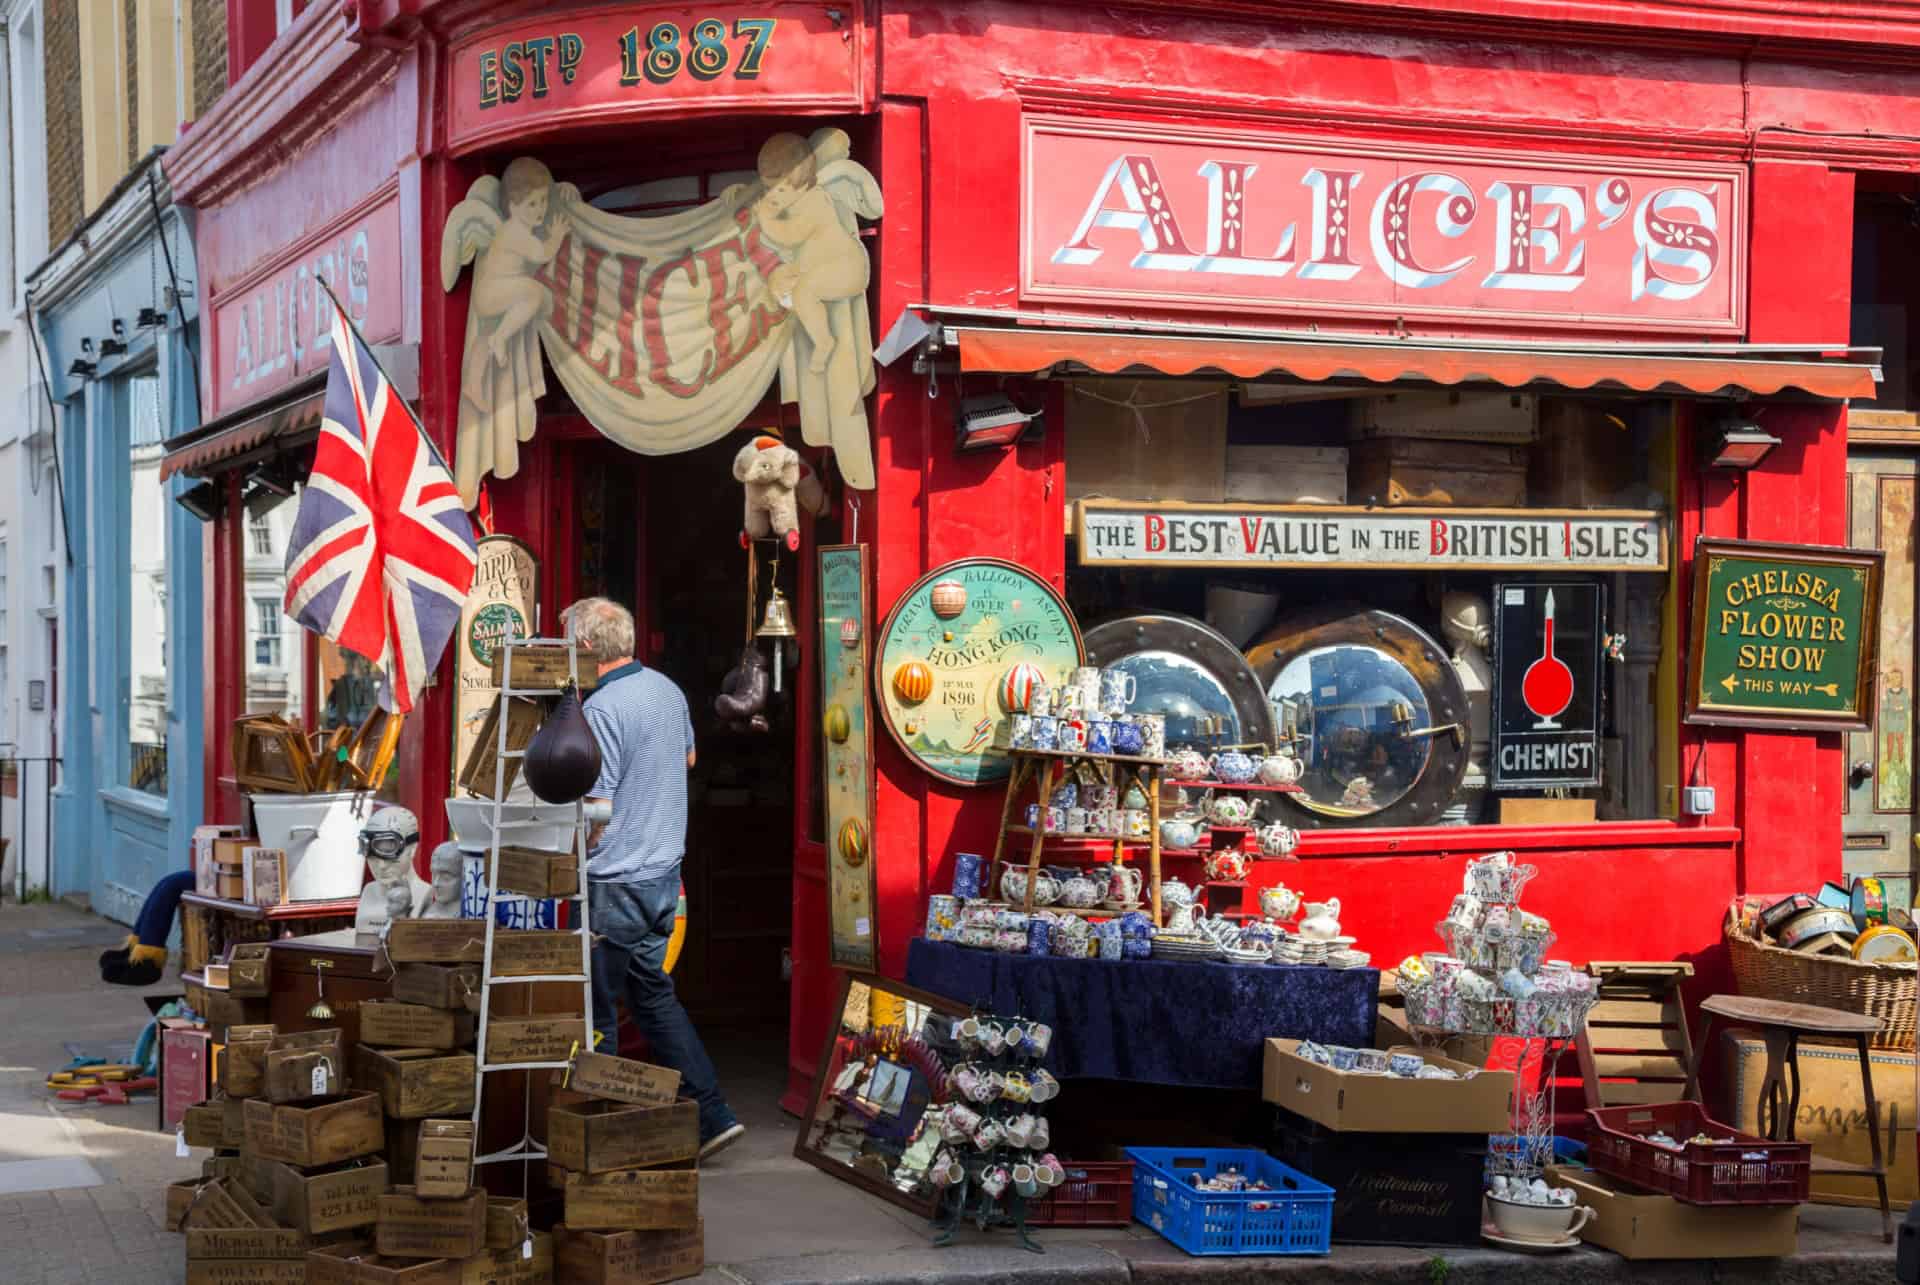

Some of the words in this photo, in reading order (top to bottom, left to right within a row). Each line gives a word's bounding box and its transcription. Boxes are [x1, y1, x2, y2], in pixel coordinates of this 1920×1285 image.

[620, 17, 778, 87] 1887
[1050, 153, 1721, 303] ALICE'S
[1095, 524, 1137, 547] THE
[1144, 513, 1228, 554] BEST
[1239, 516, 1340, 555] VALUE
[1350, 528, 1371, 550] IN
[1381, 529, 1421, 550] THE
[1429, 518, 1549, 558] BRITISH
[1563, 520, 1650, 559] ISLES
[899, 594, 931, 636] GRAND
[962, 569, 1029, 592] BALLOON
[1032, 593, 1071, 648] ASCENT
[970, 600, 1006, 612] OVER
[1726, 569, 1842, 613] CHELSEA
[1719, 609, 1847, 643] FLOWER
[925, 645, 986, 669] HONG
[989, 623, 1041, 654] KONG
[1737, 643, 1826, 673] SHOW
[942, 691, 976, 707] 1896
[1743, 678, 1775, 694] THIS
[1780, 680, 1813, 696] WAY
[1500, 742, 1595, 771] CHEMIST
